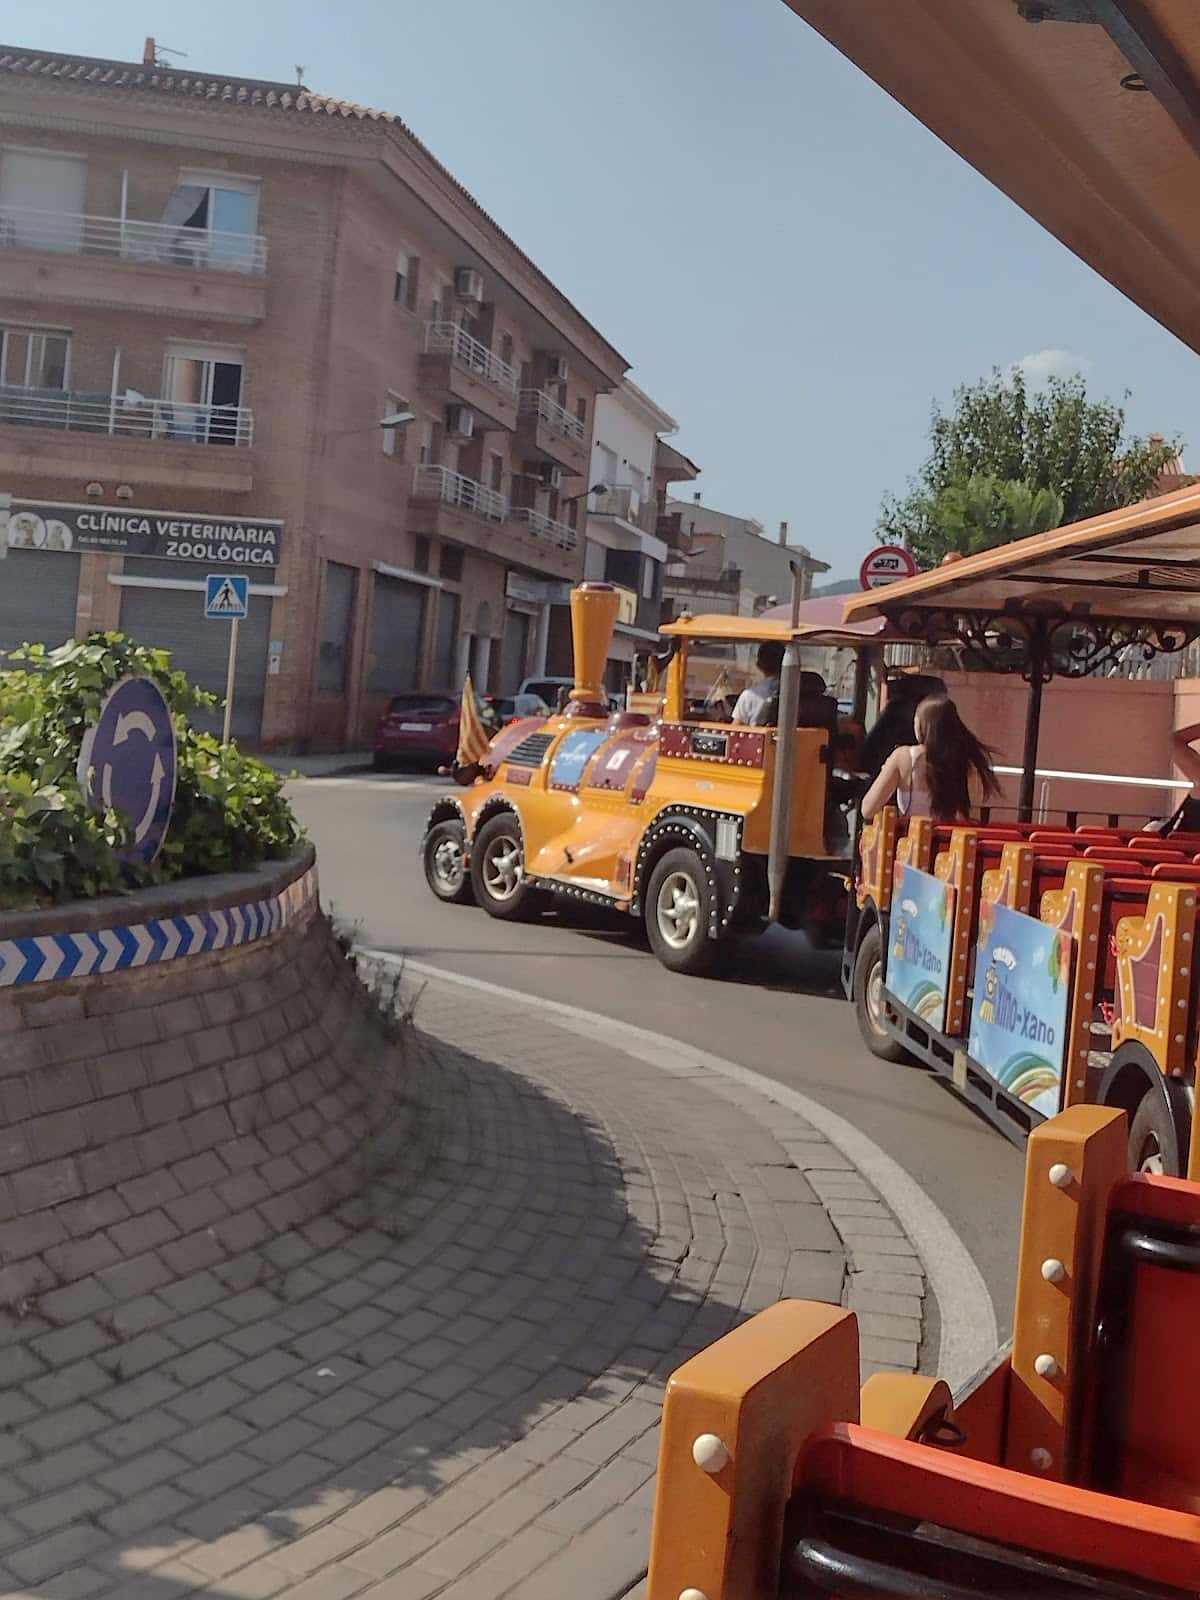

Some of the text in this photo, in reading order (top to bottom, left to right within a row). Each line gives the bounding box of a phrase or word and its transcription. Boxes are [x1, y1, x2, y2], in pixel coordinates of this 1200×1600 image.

[77, 512, 151, 535] CLÍNICA
[156, 520, 276, 545] VETERINÀRIA
[166, 541, 275, 564] ZOOLÒGICA
